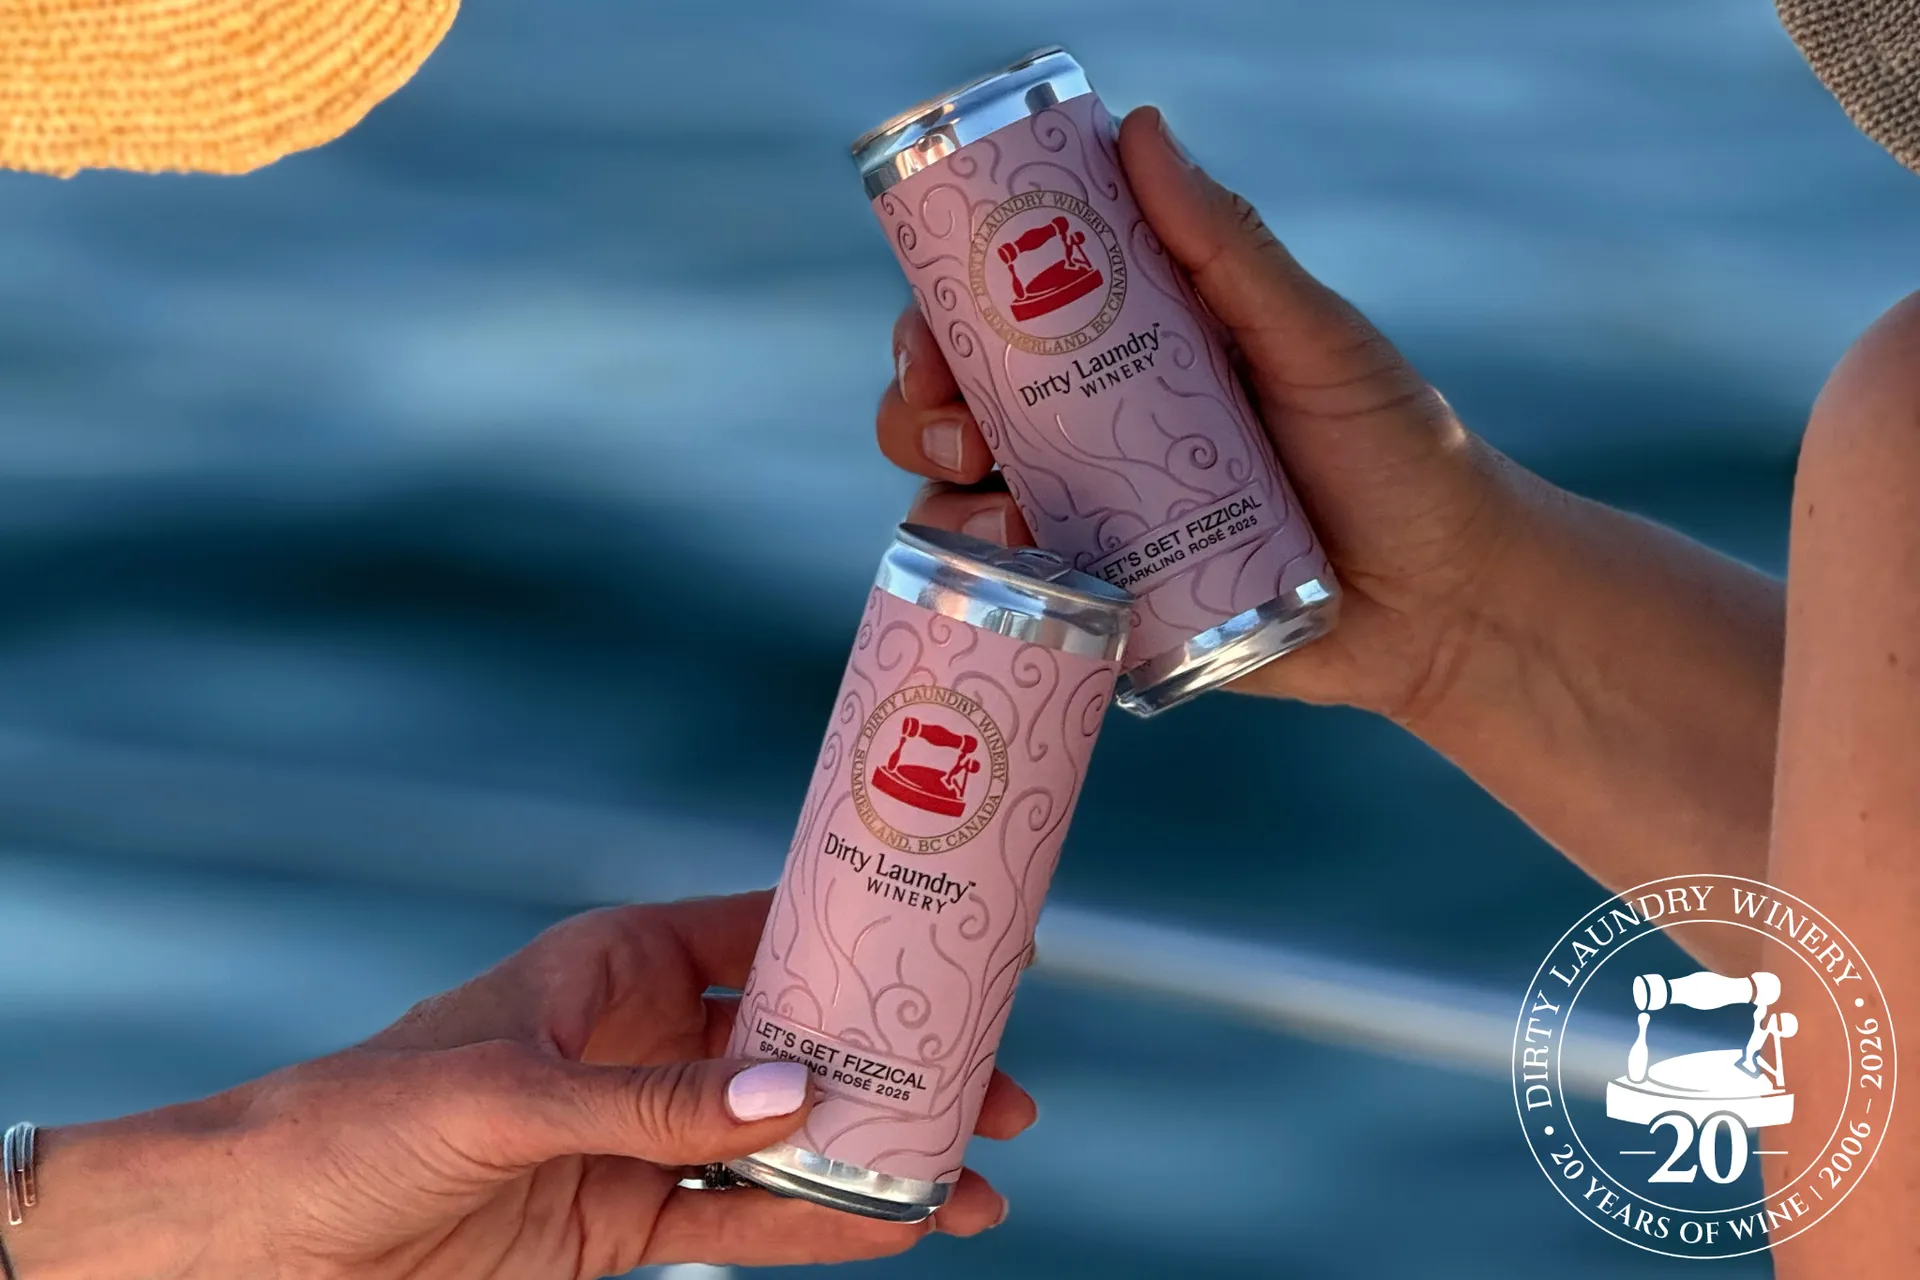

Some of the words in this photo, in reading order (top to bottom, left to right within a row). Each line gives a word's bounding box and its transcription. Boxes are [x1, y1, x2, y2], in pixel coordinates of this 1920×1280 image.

[976, 193, 1046, 242] LAUNDRY
[1052, 194, 1111, 236] WINERY
[1091, 312, 1113, 334] BC
[1107, 244, 1126, 311] CANADA
[1019, 370, 1071, 407] Dirty
[1079, 352, 1156, 398] WINERY
[1144, 530, 1181, 558] GET
[1186, 495, 1262, 539] FIZZICAL
[1188, 529, 1226, 555] ROSÉ
[1229, 515, 1258, 536] 2025
[863, 695, 898, 741] DIRTY
[902, 687, 979, 717] LAUNDRY
[979, 717, 1006, 783] WINERY
[918, 839, 942, 852] BC
[946, 795, 1001, 847] CANADA
[824, 832, 872, 873] Dirty
[866, 876, 947, 915] WINERY
[756, 1018, 797, 1048] LET'S
[800, 1039, 840, 1064] GET
[843, 1054, 927, 1090] FIZZICAL
[832, 1070, 873, 1091] ROSÉ
[876, 1083, 911, 1101] 2025
